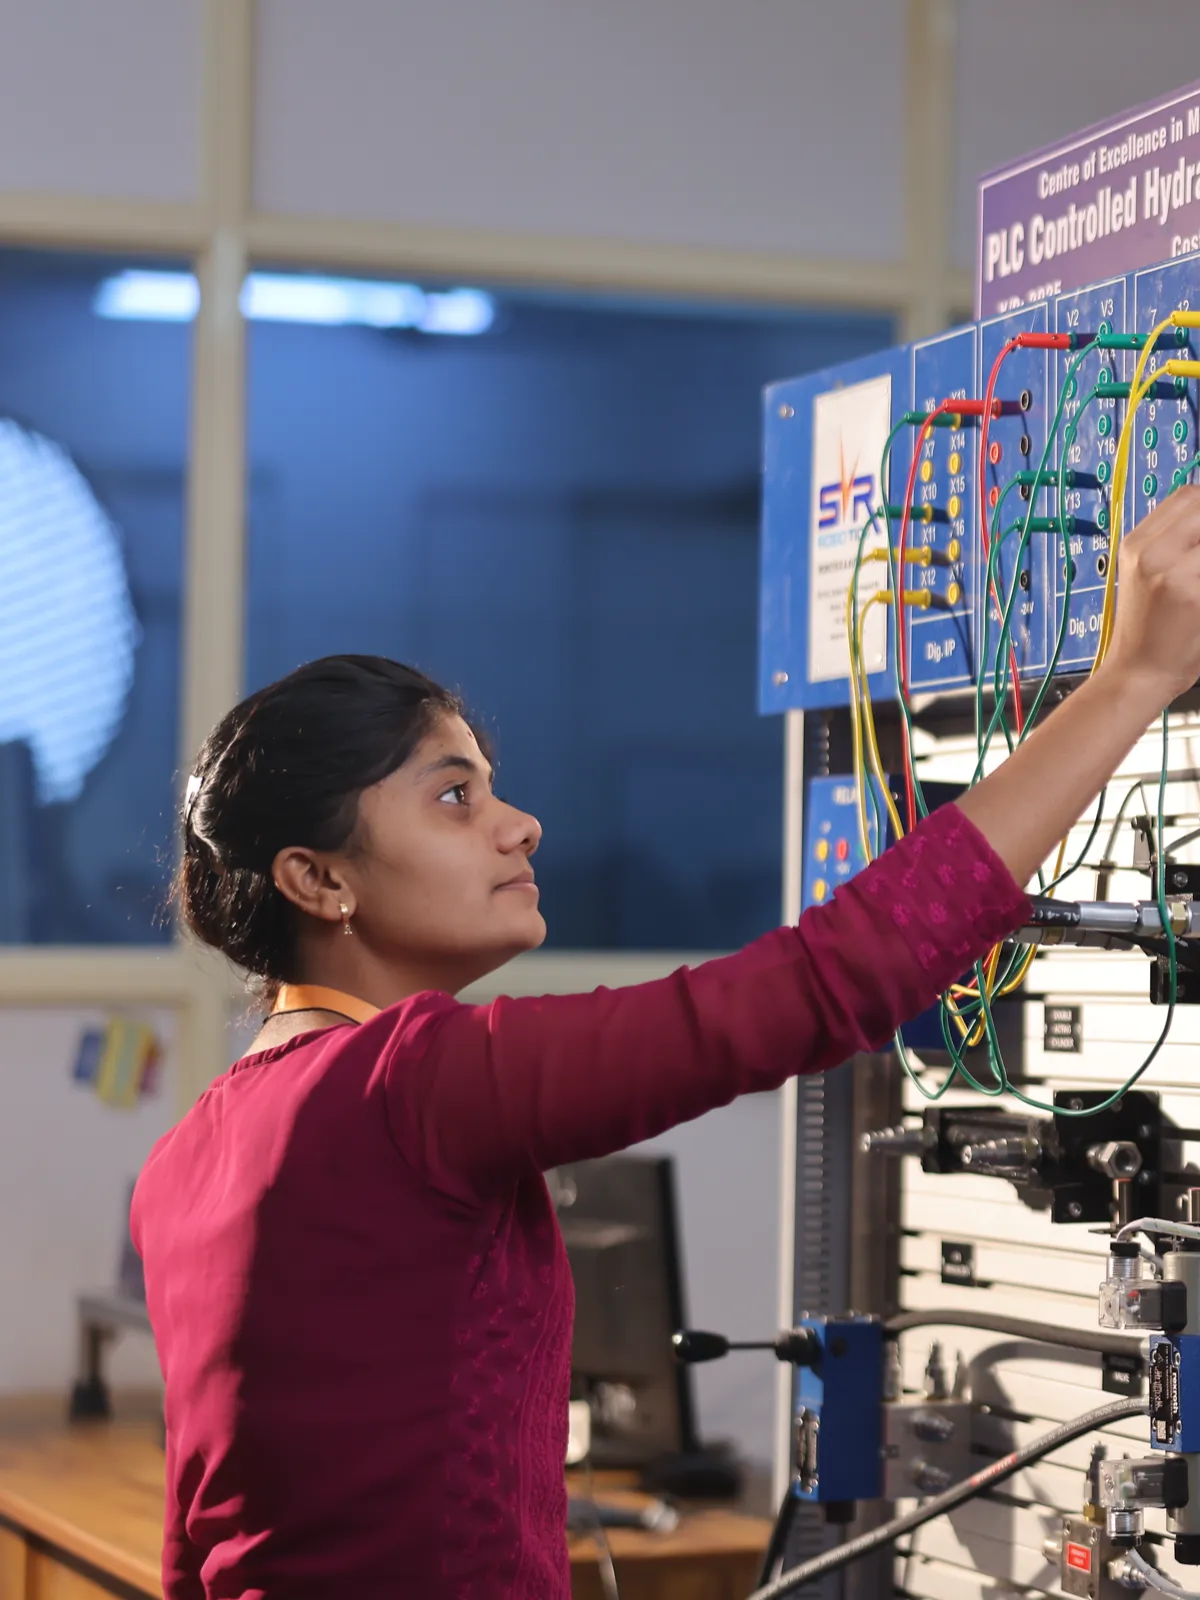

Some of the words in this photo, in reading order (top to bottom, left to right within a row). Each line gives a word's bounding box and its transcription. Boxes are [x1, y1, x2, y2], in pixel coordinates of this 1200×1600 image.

[1039, 165, 1080, 199] Centre
[1084, 152, 1096, 182] of
[1100, 126, 1167, 174] Excellence
[1171, 117, 1183, 144] in
[985, 221, 1025, 283] PLC
[1028, 175, 1137, 266] Controlled
[1101, 299, 1114, 317] V3
[1067, 309, 1079, 327] V2
[1150, 309, 1157, 327] 7
[1150, 356, 1156, 374] 8
[1149, 404, 1156, 421] 9
[1177, 396, 1188, 415] 14
[925, 440, 936, 459] X7
[950, 432, 966, 452] X14
[1097, 437, 1116, 457] Y16
[1066, 445, 1081, 466] 12
[1146, 451, 1158, 469] 10
[1176, 444, 1187, 462] 15
[922, 483, 938, 501] X10
[950, 476, 966, 495] X15
[922, 525, 936, 544] X11
[920, 568, 936, 587] X12
[1069, 617, 1087, 638] Dig.
[926, 641, 943, 663] Dig.
